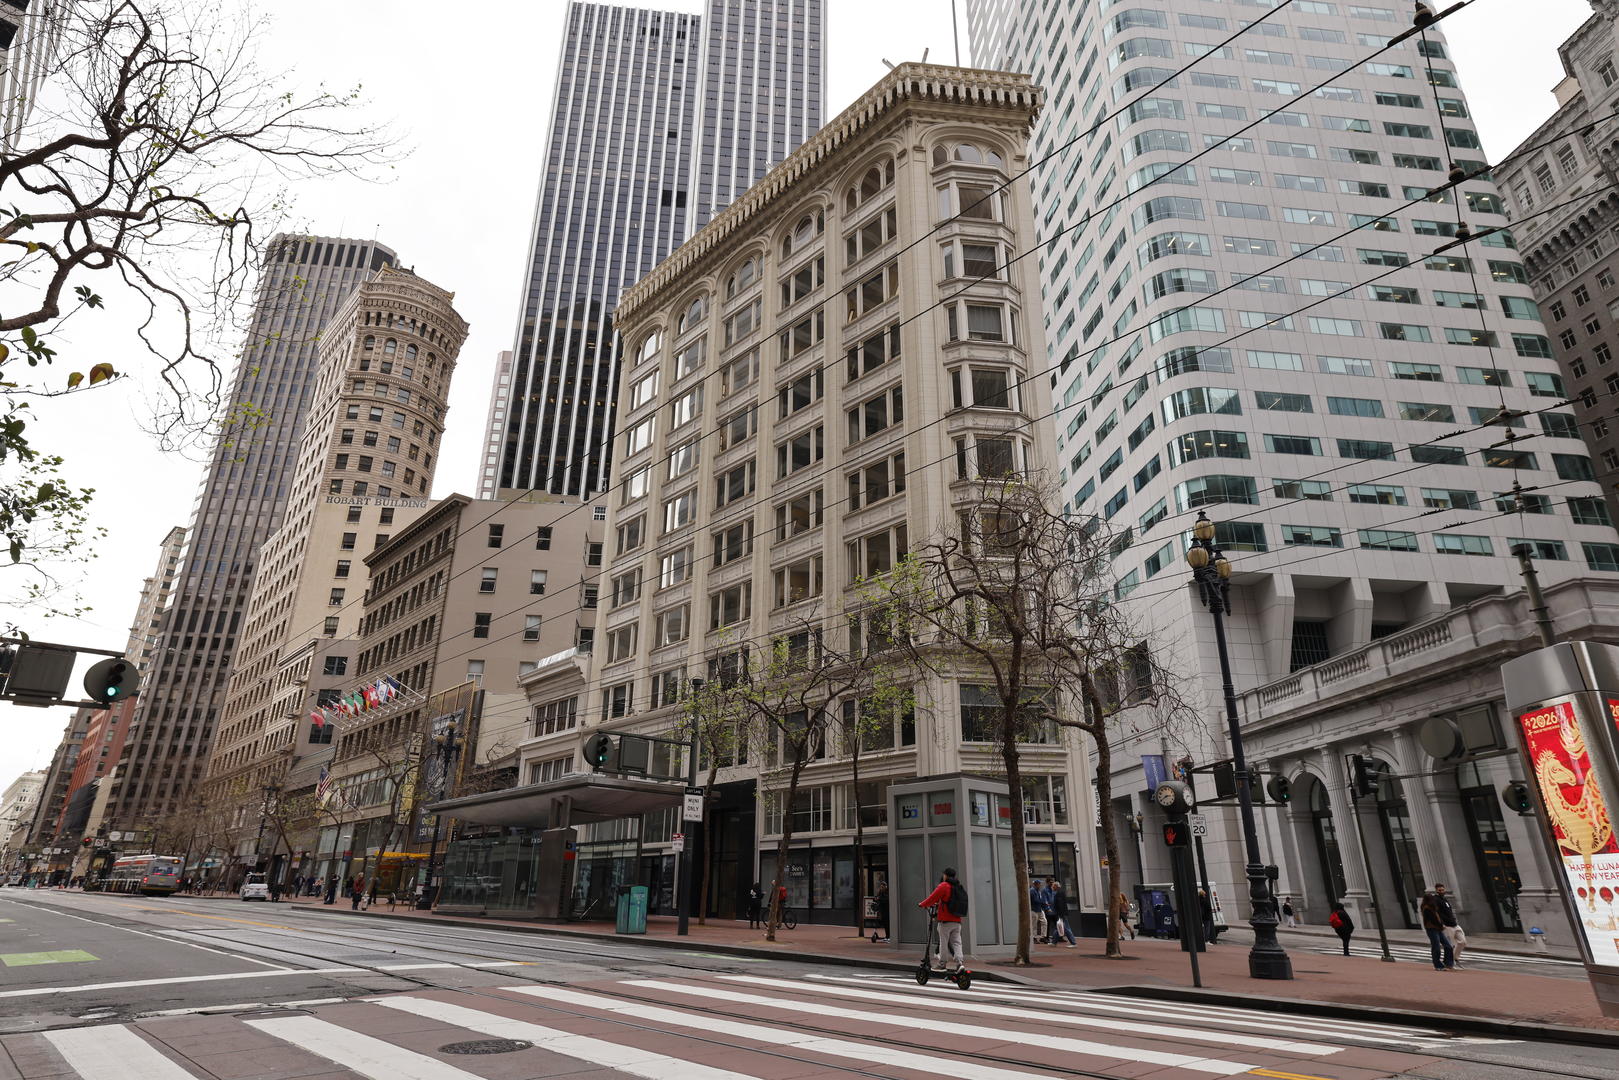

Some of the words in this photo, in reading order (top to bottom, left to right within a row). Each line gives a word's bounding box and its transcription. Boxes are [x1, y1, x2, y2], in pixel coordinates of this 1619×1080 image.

[326, 496, 371, 506] HOBART
[374, 498, 428, 509] BUILDING
[1530, 711, 1558, 729] 2026
[1192, 825, 1206, 834] 20
[1568, 863, 1595, 872] HAPPY
[1578, 872, 1598, 881] NEW
